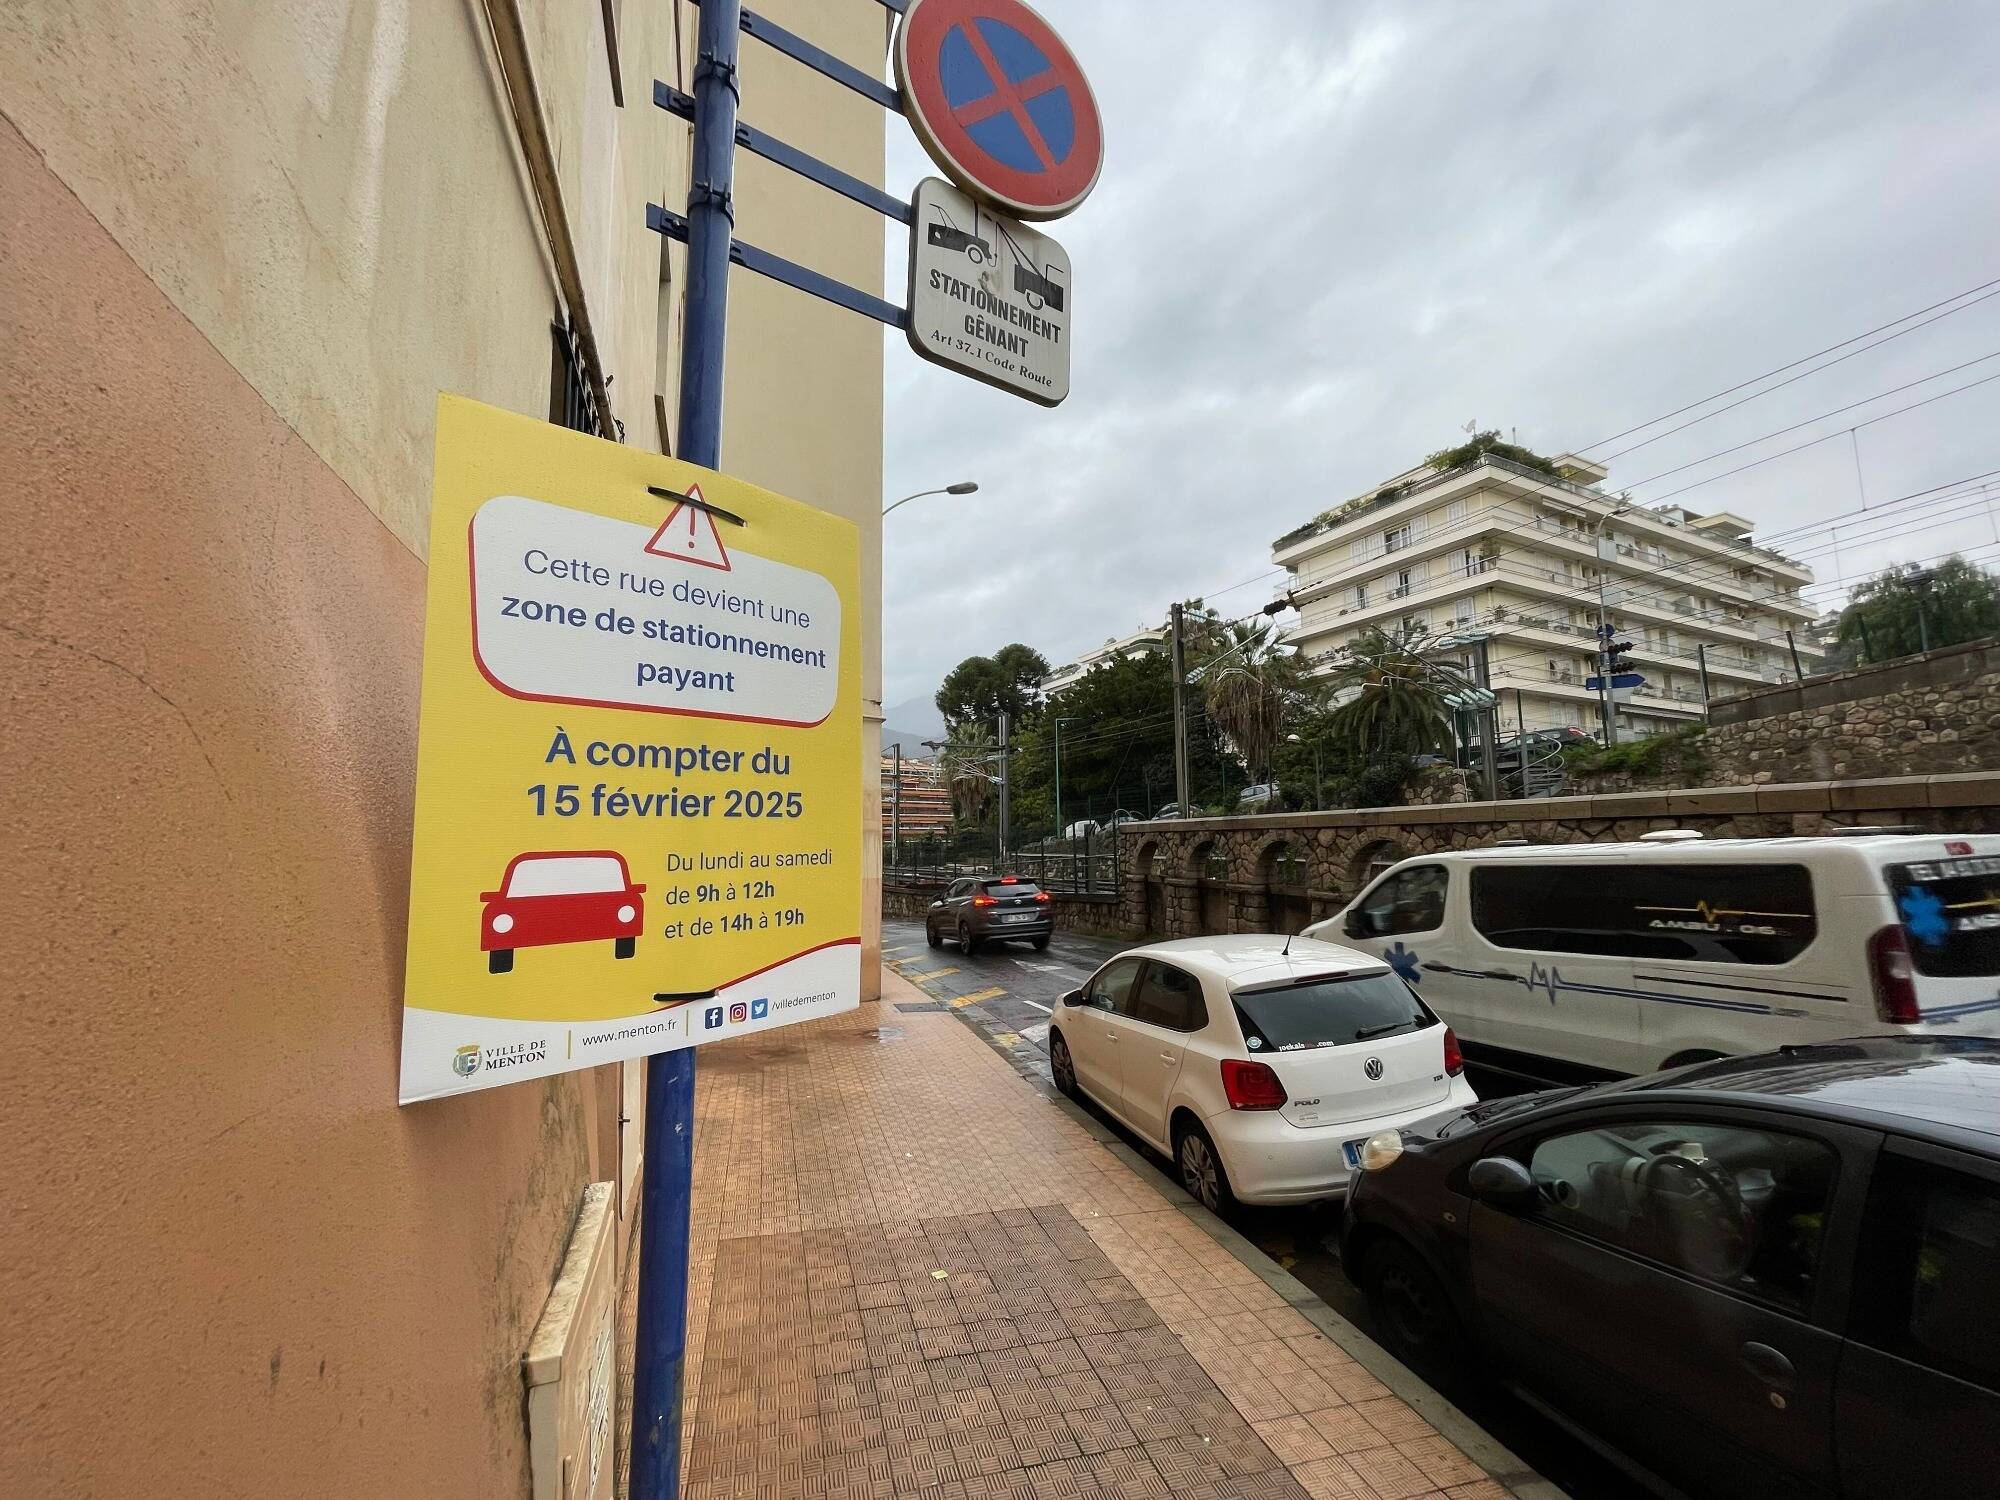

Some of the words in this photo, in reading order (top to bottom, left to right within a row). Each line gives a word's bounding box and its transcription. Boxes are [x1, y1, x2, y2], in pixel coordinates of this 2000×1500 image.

[930, 269, 1060, 343] STATIONNEMENT
[965, 314, 1028, 357] GÊNANT
[931, 330, 952, 345] Art
[986, 352, 1014, 372] Code
[1019, 365, 1052, 386] Route
[524, 549, 609, 586] Cette
[619, 572, 665, 597] rue
[673, 580, 764, 619] devient
[770, 606, 810, 628] une
[501, 597, 586, 627] zone
[595, 608, 635, 634] de
[643, 619, 826, 668] stationnement
[637, 661, 734, 692] payant
[546, 726, 575, 764] À
[586, 740, 744, 776] compter
[752, 747, 790, 775] du
[527, 784, 580, 816] 15
[592, 784, 715, 817] février
[724, 790, 803, 818] 2025
[668, 854, 692, 872] Du
[700, 851, 743, 871] lundi
[750, 854, 770, 868] au
[776, 850, 832, 867] samedi
[666, 886, 689, 905] de
[696, 884, 719, 902] 9h
[727, 883, 736, 900] à
[743, 882, 775, 899] 12h
[664, 921, 683, 938] et
[691, 917, 713, 936] de
[720, 914, 753, 932] 14h
[759, 912, 768, 928] à
[774, 910, 804, 927] 19h
[772, 990, 835, 1011] /villedementon
[582, 1018, 677, 1047] www.menton.fr
[486, 1042, 525, 1058] VILLE
[531, 1040, 546, 1050] DE
[486, 1050, 546, 1071] MENTON
